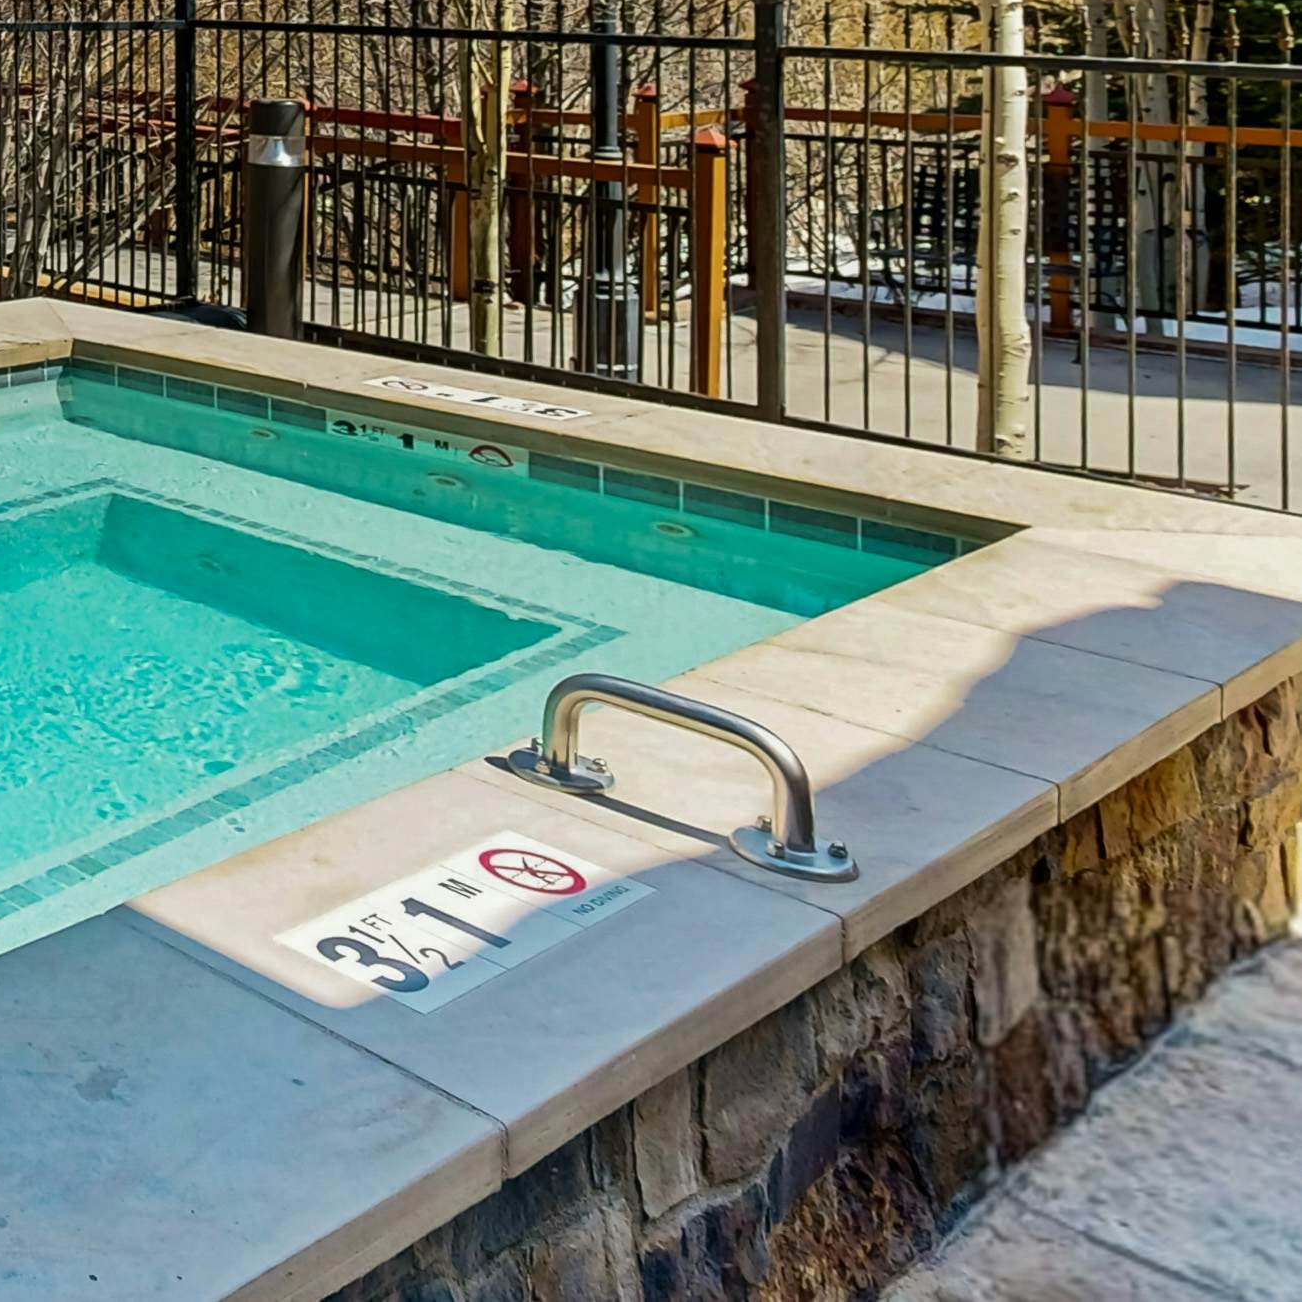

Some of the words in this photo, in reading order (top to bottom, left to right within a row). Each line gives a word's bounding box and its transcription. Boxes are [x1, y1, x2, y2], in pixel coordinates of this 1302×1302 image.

[438, 878, 483, 899] M
[572, 901, 595, 917] NO
[592, 885, 629, 908] DIVING
